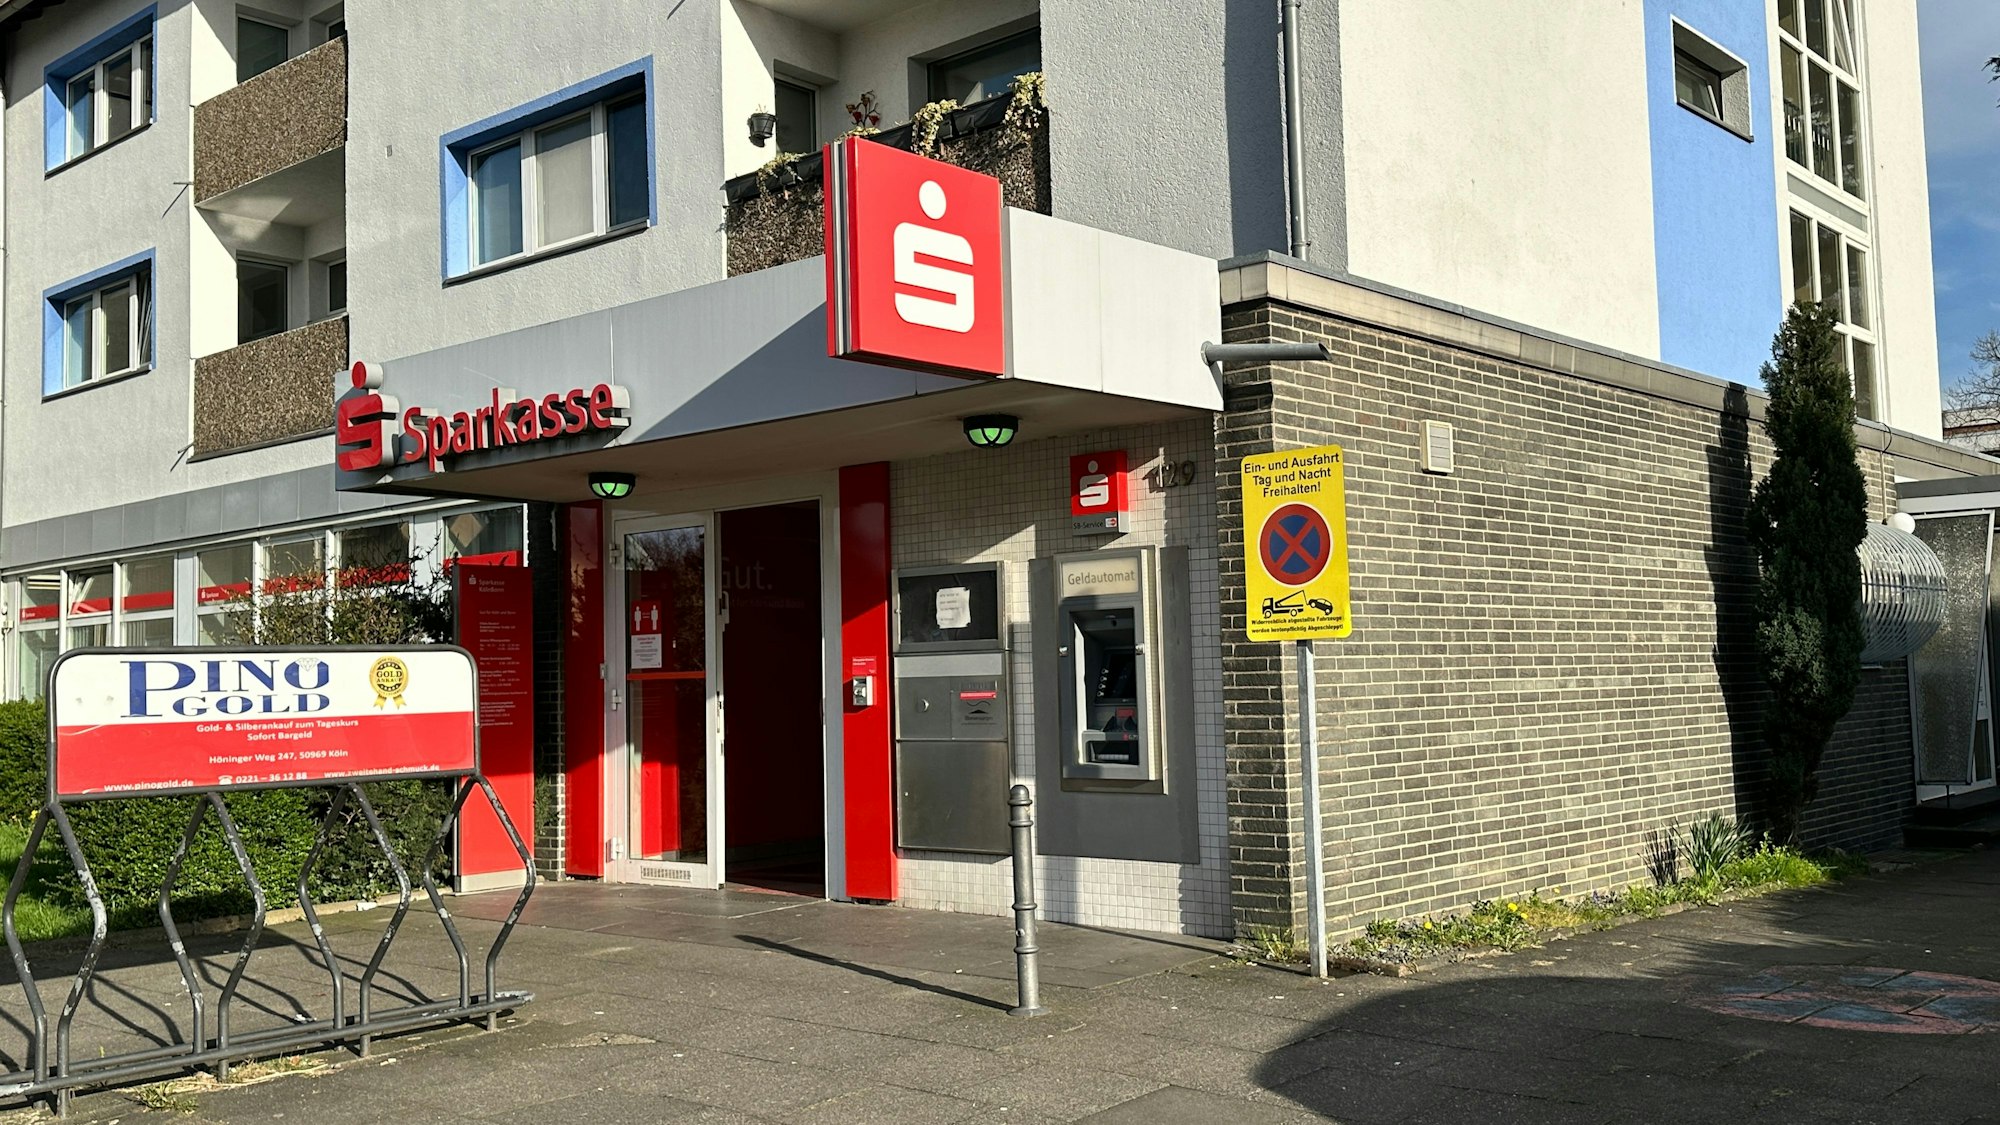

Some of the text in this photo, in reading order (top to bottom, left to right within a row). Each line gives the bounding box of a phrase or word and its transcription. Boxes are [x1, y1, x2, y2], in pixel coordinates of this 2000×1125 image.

[404, 384, 613, 472] Sparkasse
[1244, 453, 1339, 474] Ein- und Ausfahrt
[1252, 467, 1331, 487] Tag und Nacht
[1263, 481, 1321, 497] Freihalten!
[1073, 521, 1104, 530] SB-Service
[1067, 570, 1136, 586] Geldautomat
[376, 670, 402, 678] GOLD
[120, 659, 329, 718] PINO
[172, 693, 330, 717] GOLD
[196, 719, 358, 732] Gold- & Silberankauf zum Tageskurs
[247, 731, 312, 741] Sofort Bargeld
[209, 749, 348, 764] Höninger Weg 247, 50969 Köln
[104, 779, 194, 792] www.pinogold.de
[235, 775, 259, 784] 0221
[269, 773, 282, 782] 36
[283, 773, 294, 781] 12
[296, 772, 307, 780] 88
